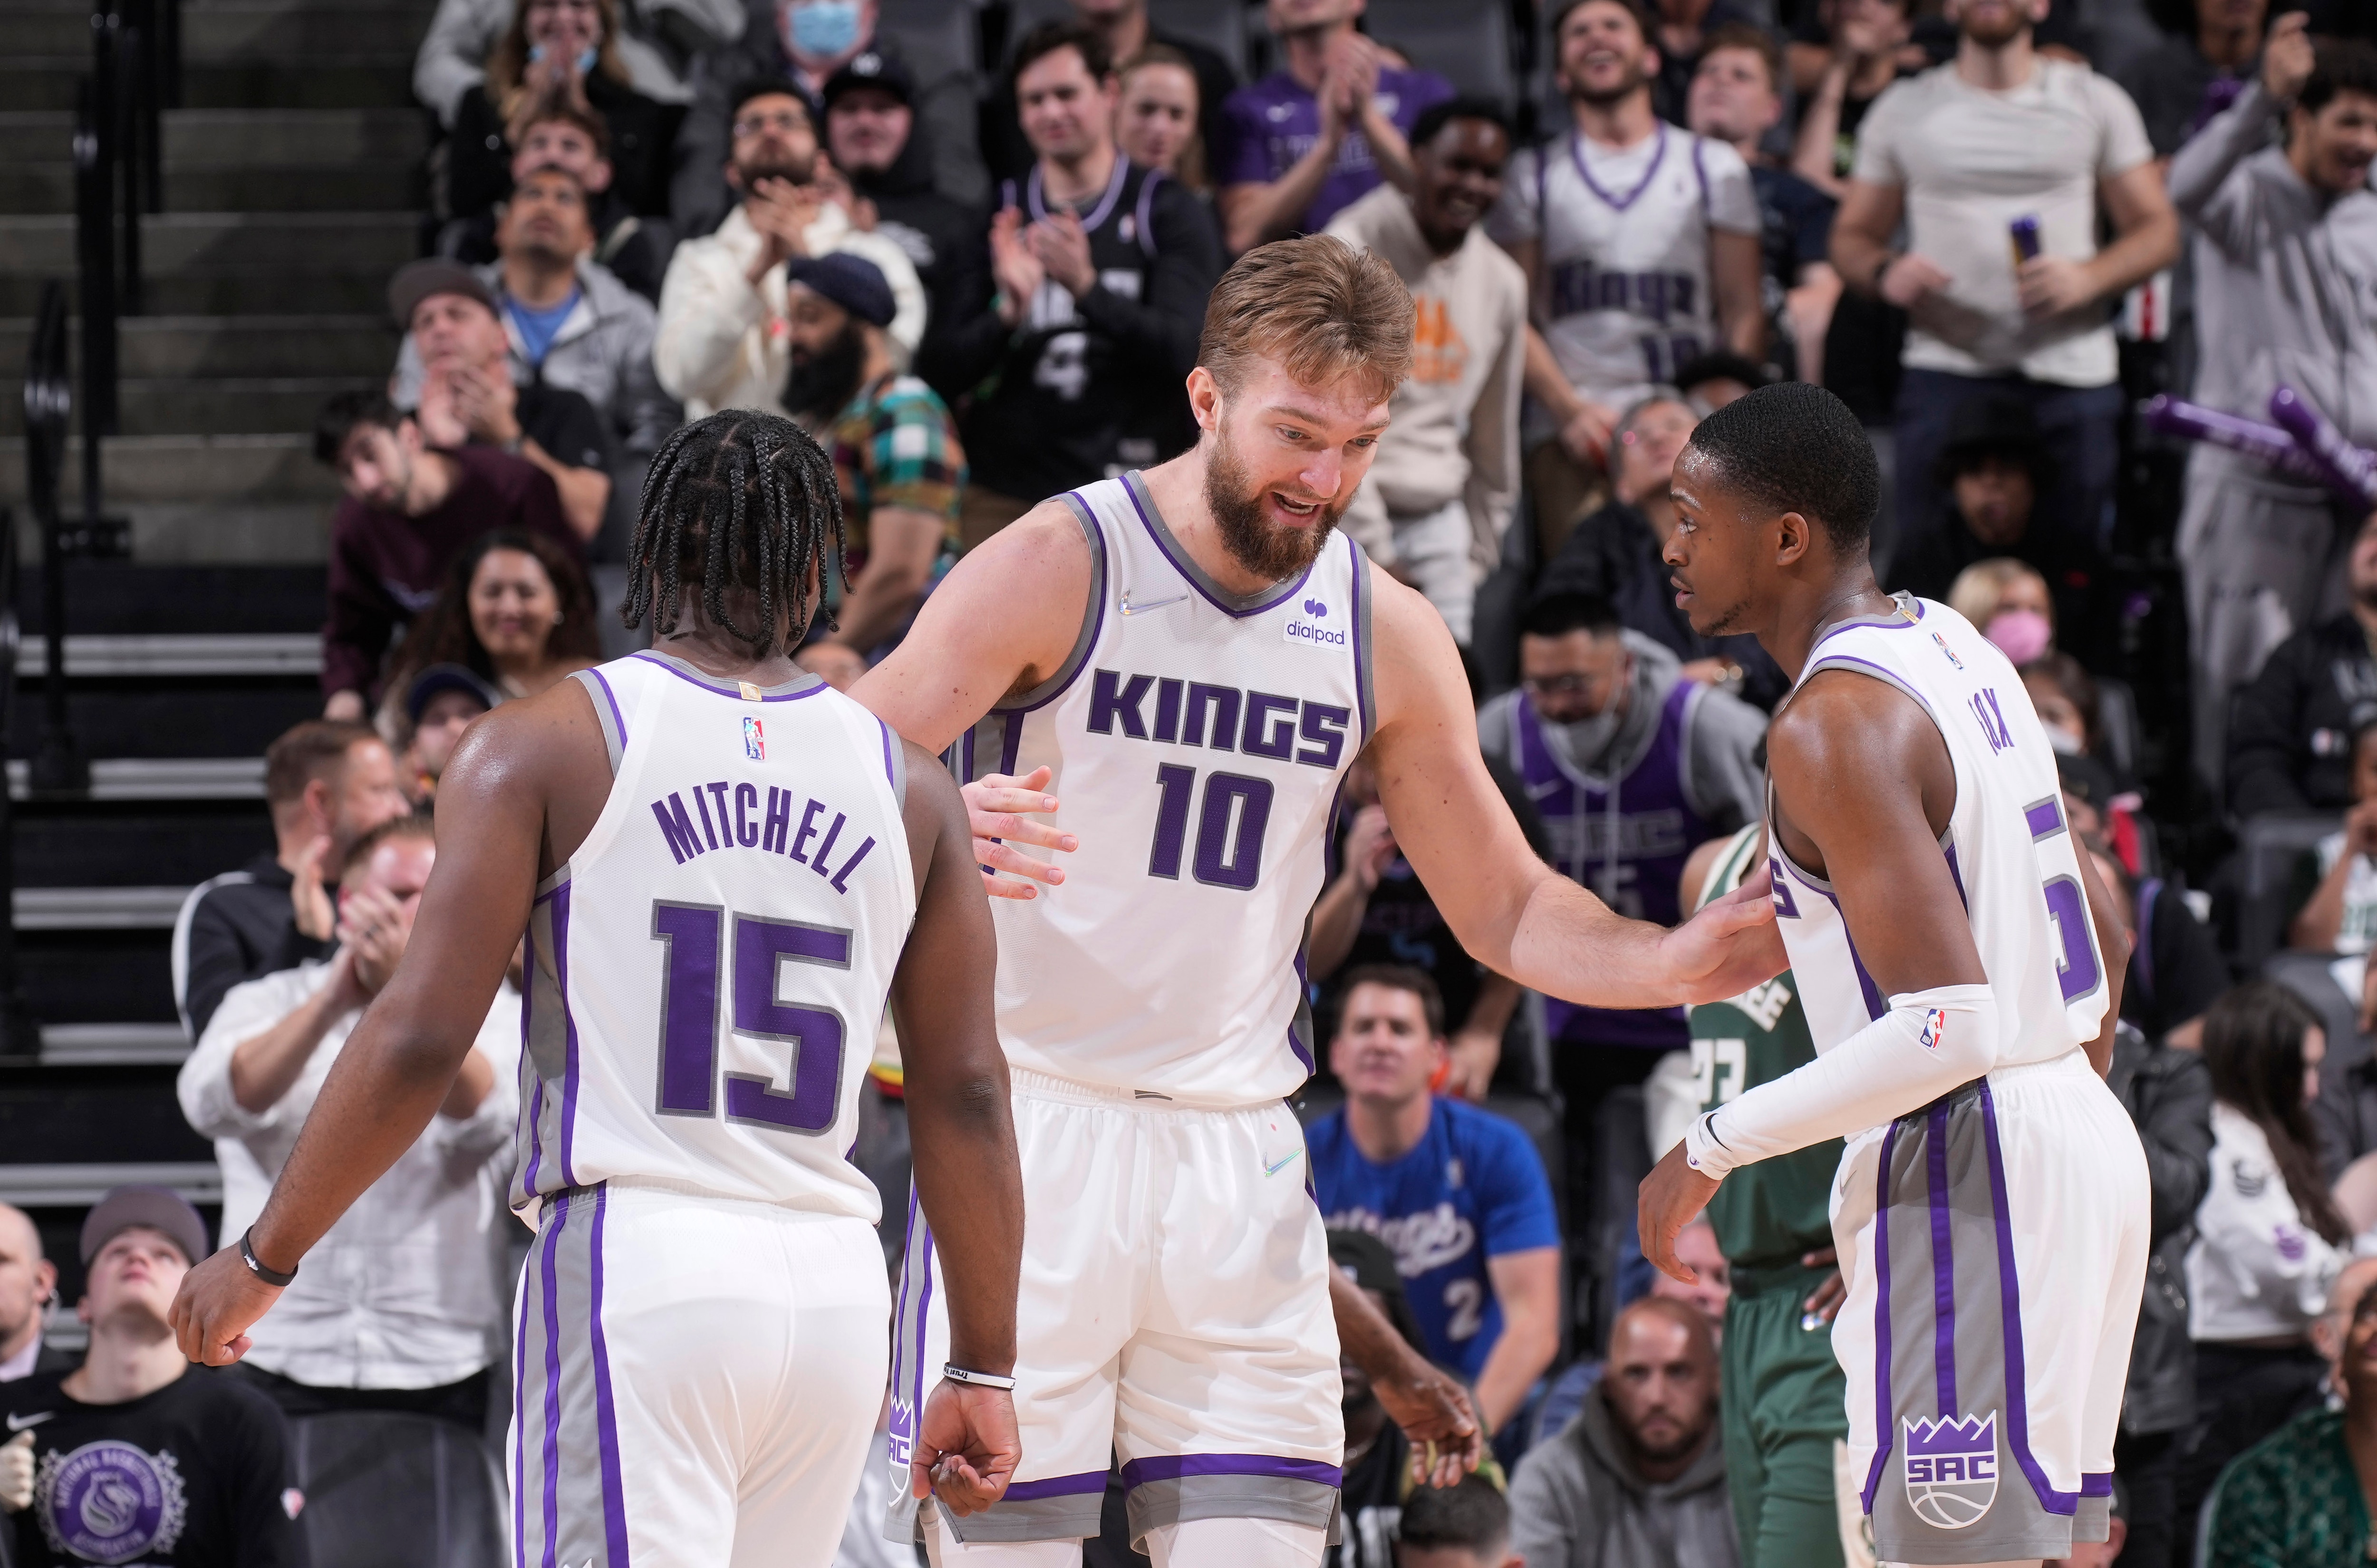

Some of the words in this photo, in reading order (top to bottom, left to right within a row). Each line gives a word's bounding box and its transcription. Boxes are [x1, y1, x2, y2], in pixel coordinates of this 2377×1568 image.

[1287, 620, 1344, 645] dialpad
[1087, 668, 1351, 770] KINGS
[1968, 688, 2015, 756] FOX
[651, 781, 876, 895] MITCHELL
[1148, 762, 1275, 890] 10
[650, 898, 854, 1137] 15
[1921, 1034, 1932, 1045] NBA
[1443, 1279, 1487, 1342] 2
[950, 1369, 968, 1379] Trust
[889, 1437, 909, 1465] AC
[1908, 1455, 1995, 1483] SAC
